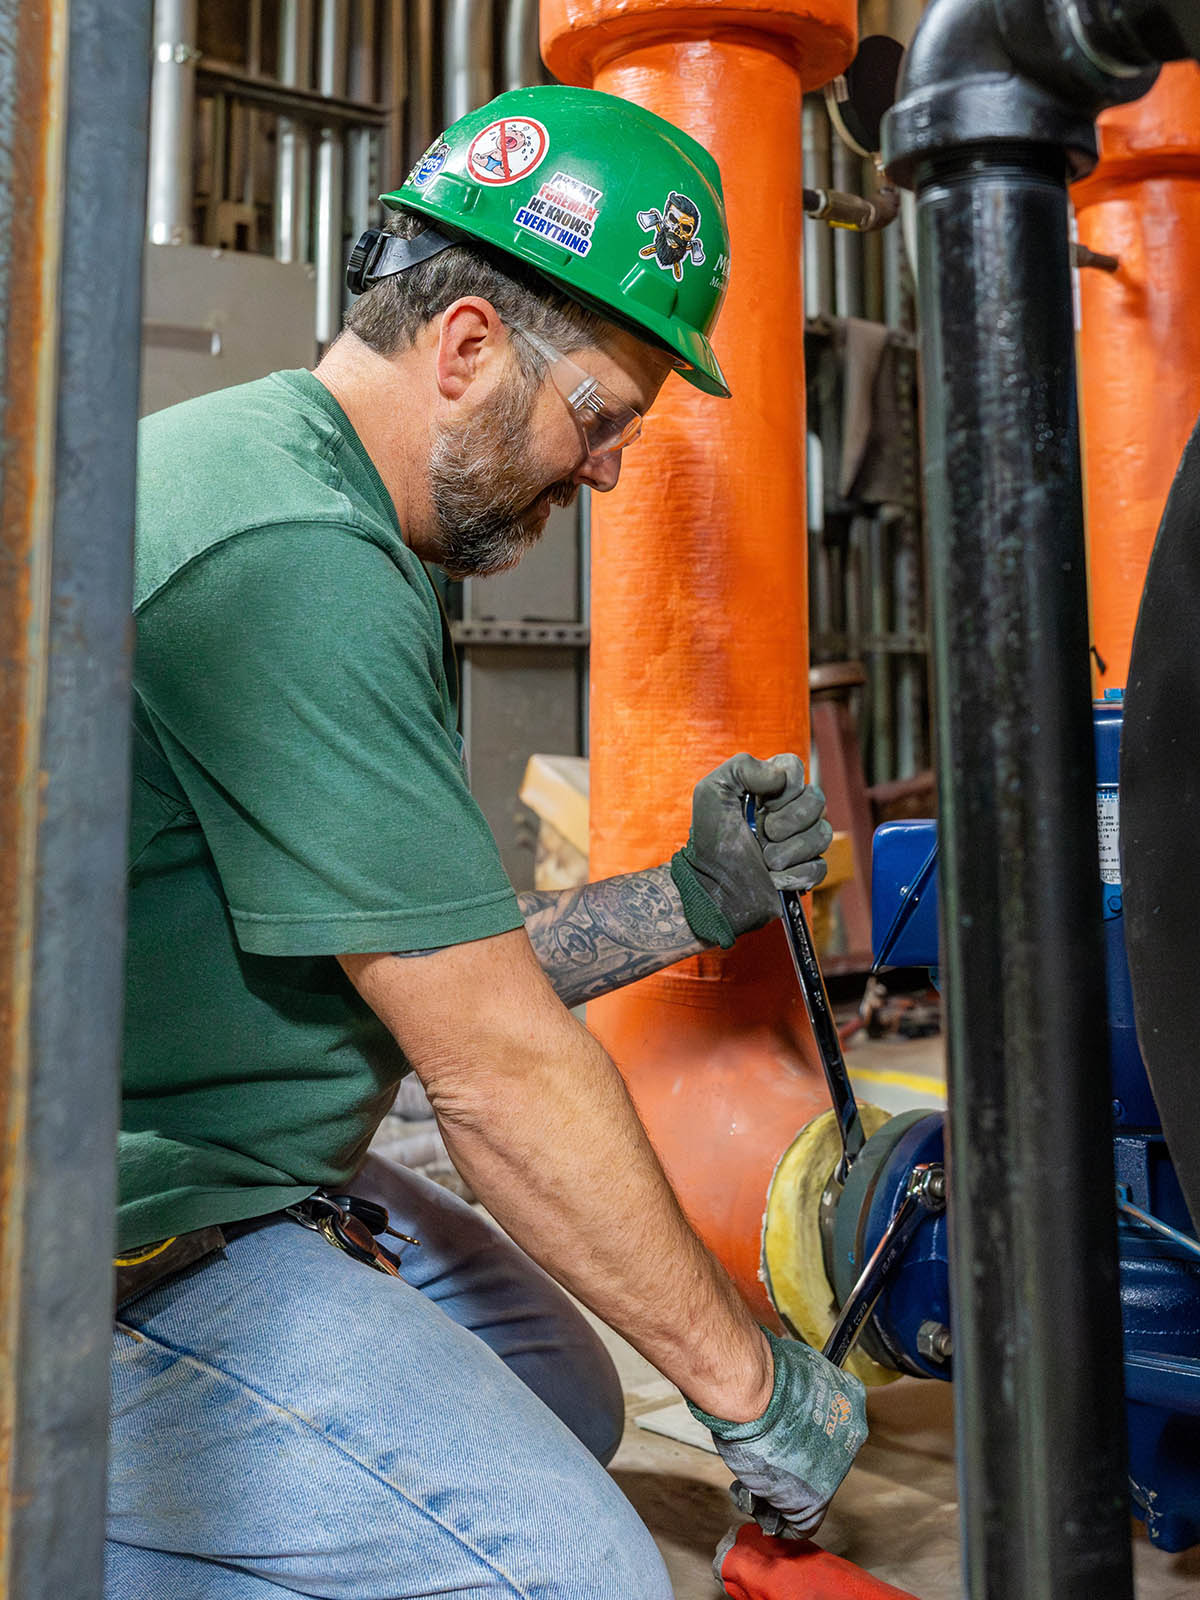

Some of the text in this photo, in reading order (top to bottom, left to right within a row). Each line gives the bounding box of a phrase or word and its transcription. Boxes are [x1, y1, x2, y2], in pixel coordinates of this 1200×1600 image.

[528, 197, 592, 237] HE KNOWS
[539, 184, 597, 221] FOREMAN
[515, 209, 589, 254] EVERYTHING
